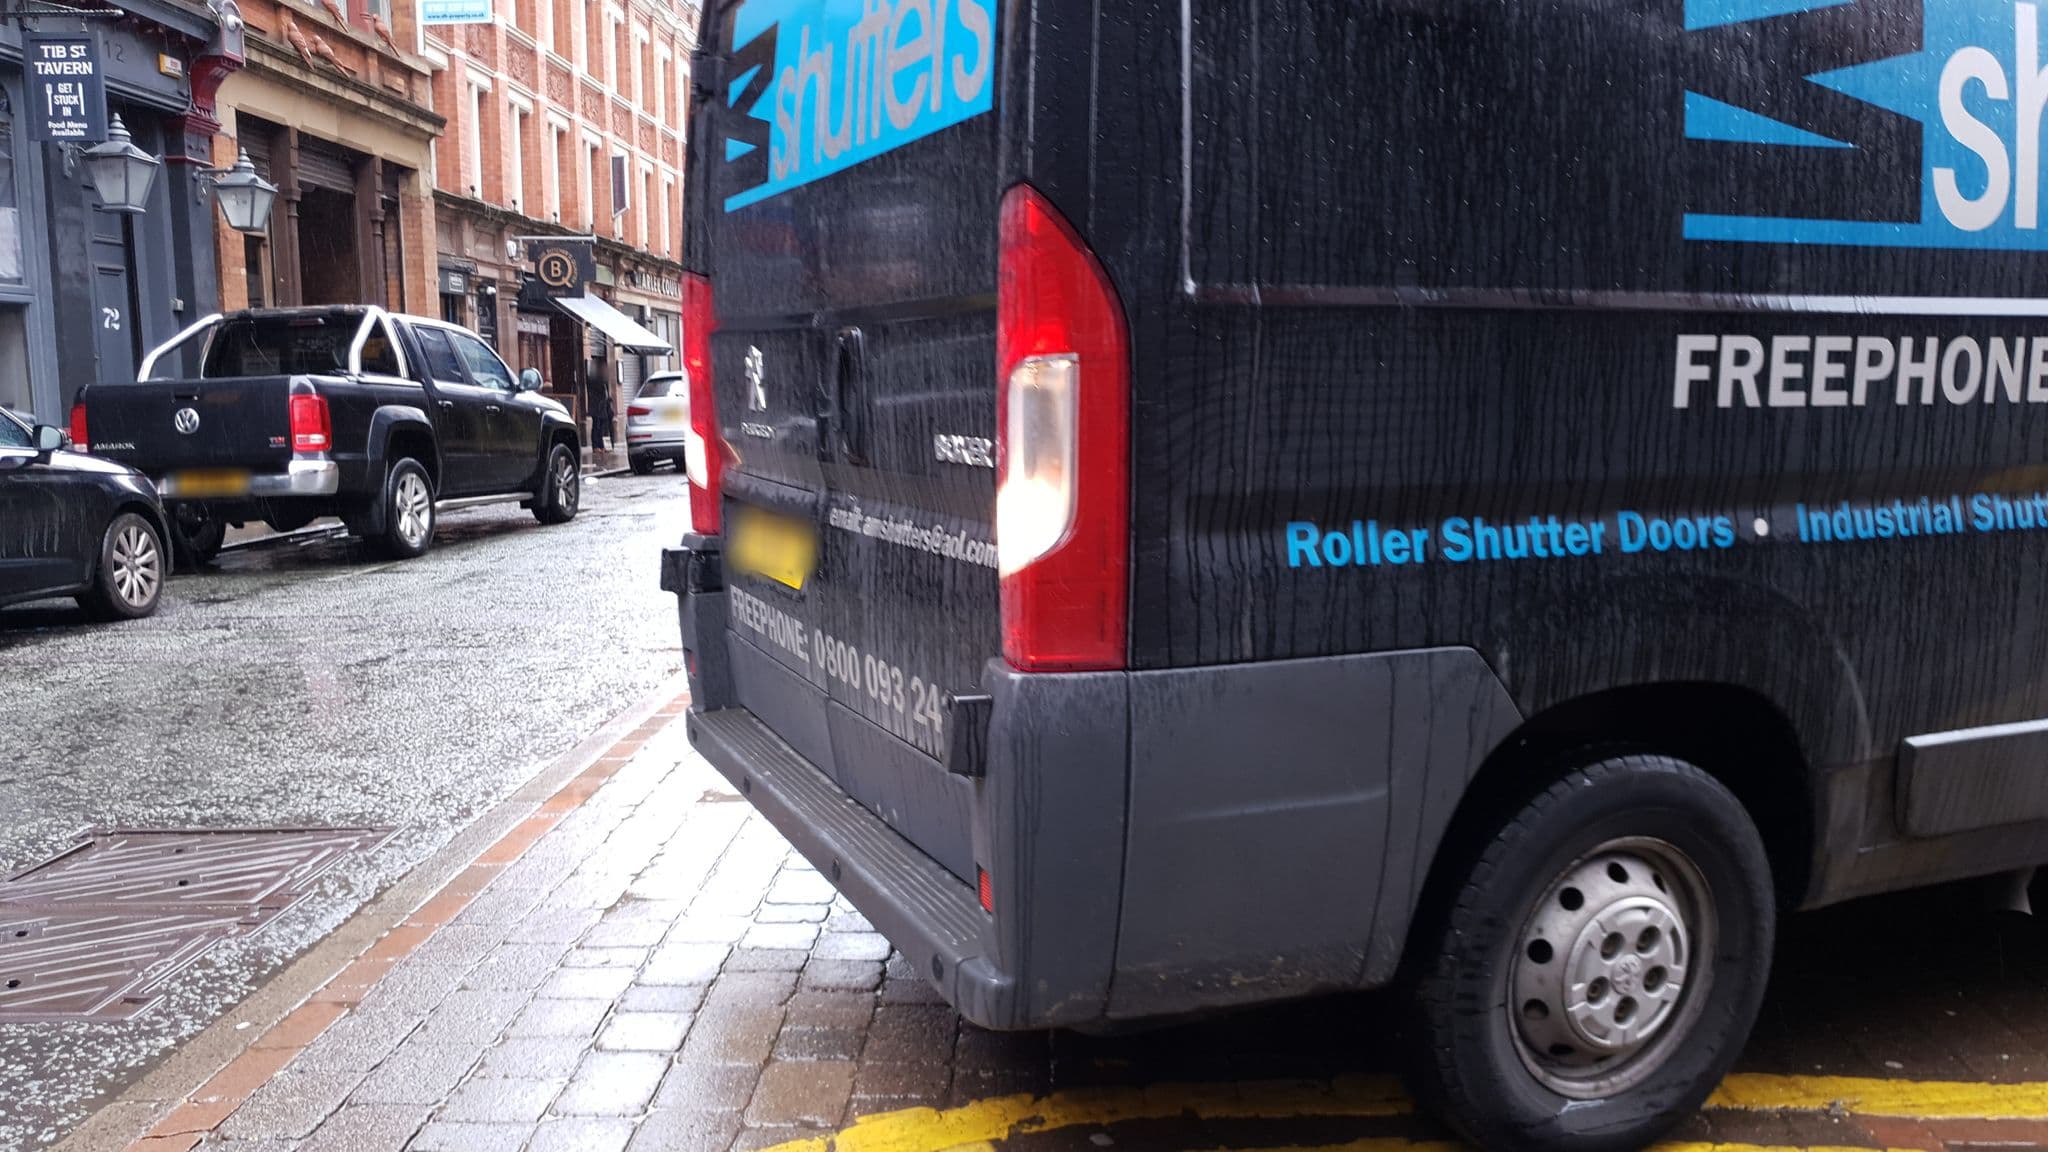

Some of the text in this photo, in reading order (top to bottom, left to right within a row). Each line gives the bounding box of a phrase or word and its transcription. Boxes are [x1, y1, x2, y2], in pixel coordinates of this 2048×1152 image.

[40, 45, 67, 59] TIB
[34, 61, 93, 75] TAVERN
[57, 83, 73, 94] GET
[53, 94, 80, 106] STUCK
[62, 106, 72, 117] IN
[48, 120, 88, 129] Food Menu
[52, 129, 85, 137] Available
[101, 306, 121, 331] 72
[93, 442, 136, 450] AMAROK
[1796, 491, 2048, 543] Industrial Shut
[1285, 510, 1736, 568] Roller Shutter Doors
[730, 584, 949, 733] FREEPHONE: 0800 093 24
